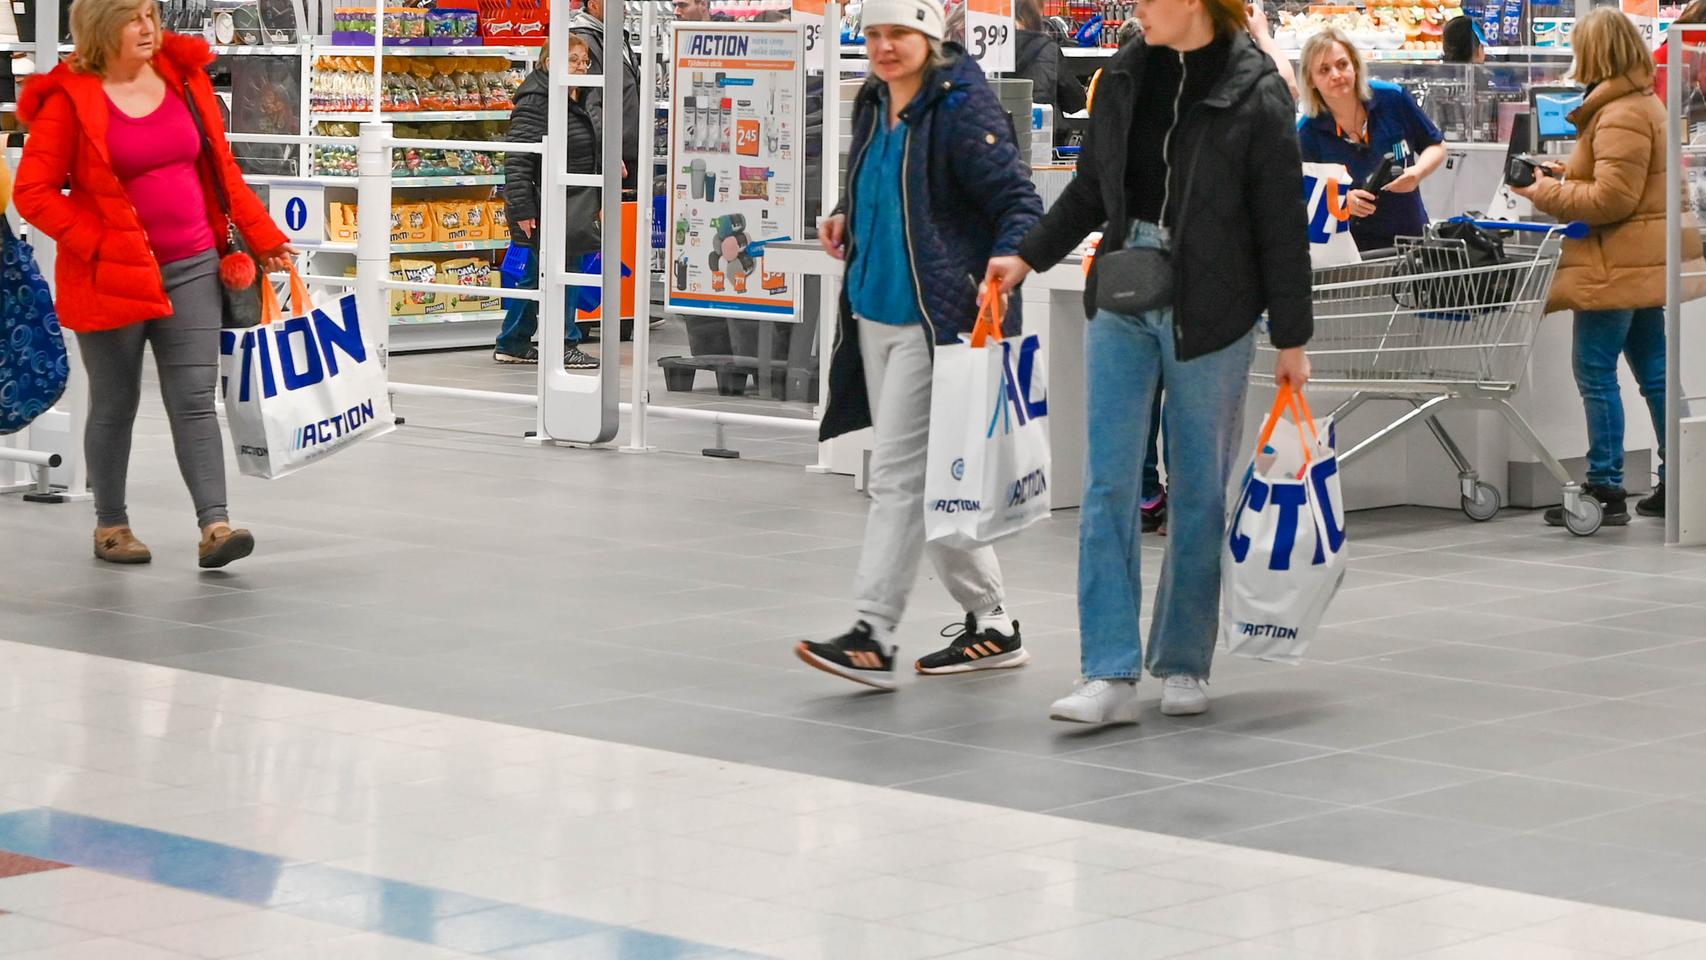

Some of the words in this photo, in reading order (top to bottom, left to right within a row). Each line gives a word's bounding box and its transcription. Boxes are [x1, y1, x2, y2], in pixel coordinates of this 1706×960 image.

[806, 24, 825, 51] 39
[1638, 23, 1654, 40] 79
[690, 34, 749, 57] ACTION
[973, 24, 1008, 60] 399
[737, 129, 758, 147] 245
[302, 398, 375, 449] ACTION
[935, 499, 982, 514] ACTION
[1243, 622, 1299, 640] ACTION
